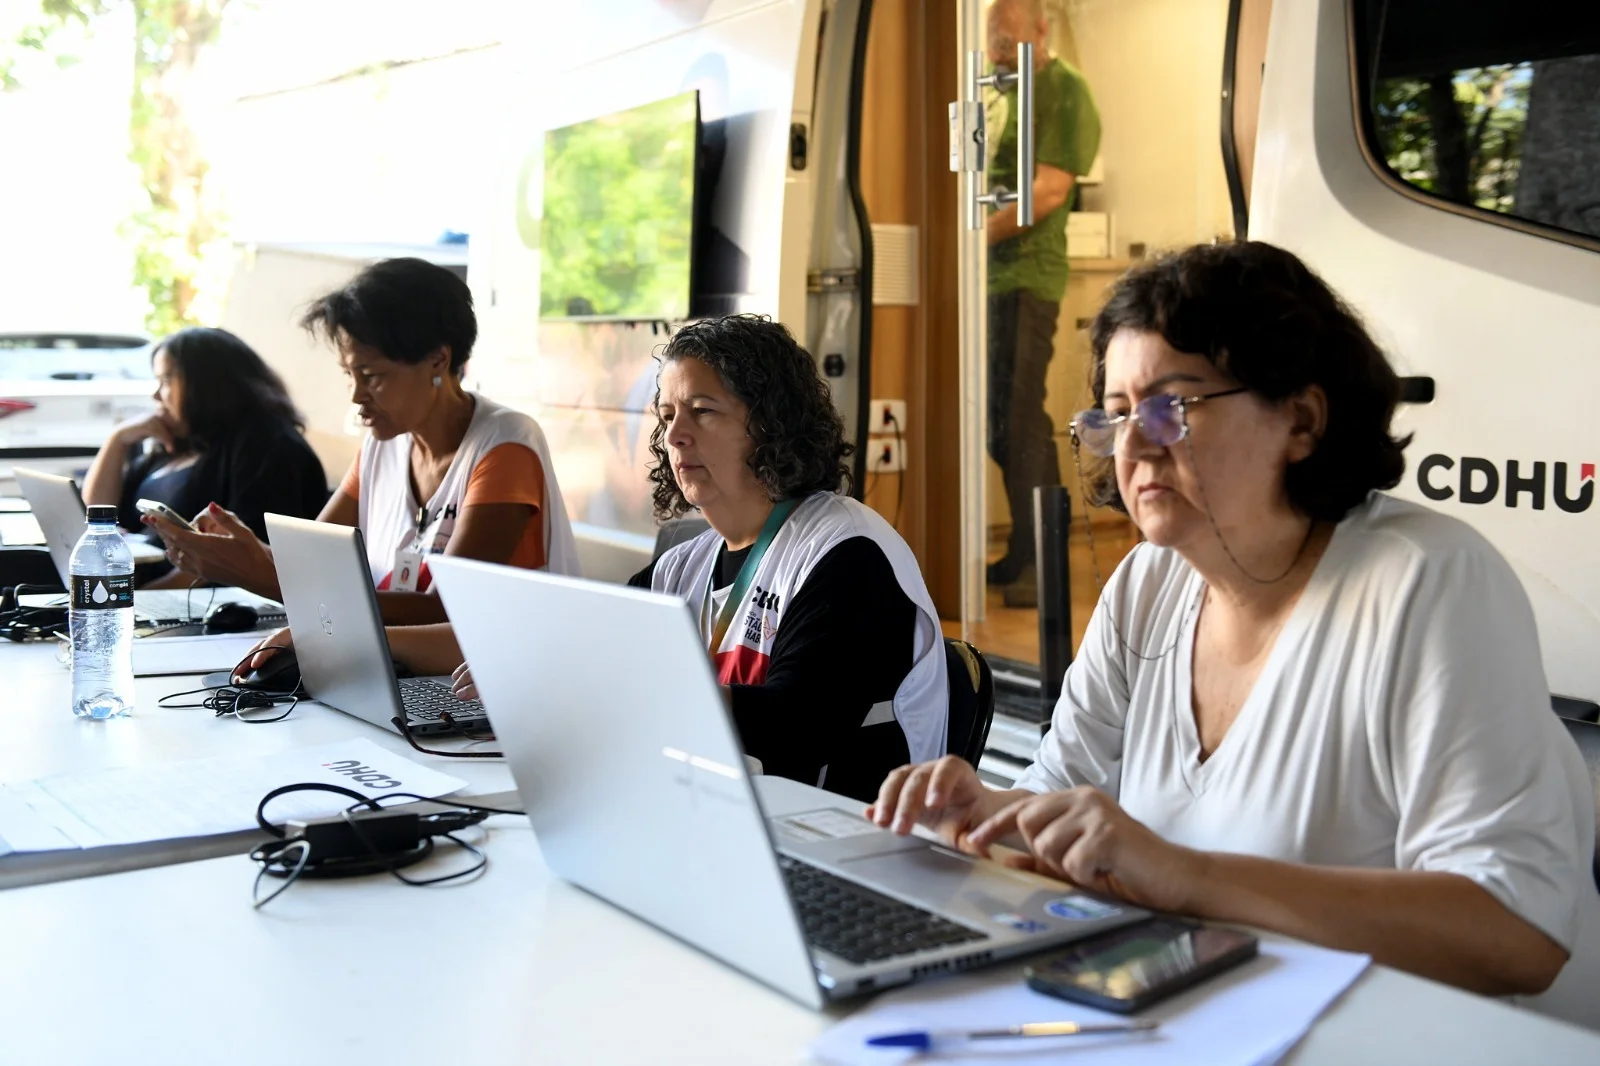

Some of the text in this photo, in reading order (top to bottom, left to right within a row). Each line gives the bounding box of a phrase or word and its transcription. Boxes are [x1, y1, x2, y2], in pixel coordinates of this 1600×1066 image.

[1417, 453, 1595, 513] CDHU
[83, 580, 91, 604] crystal
[321, 760, 402, 789] CDHU
